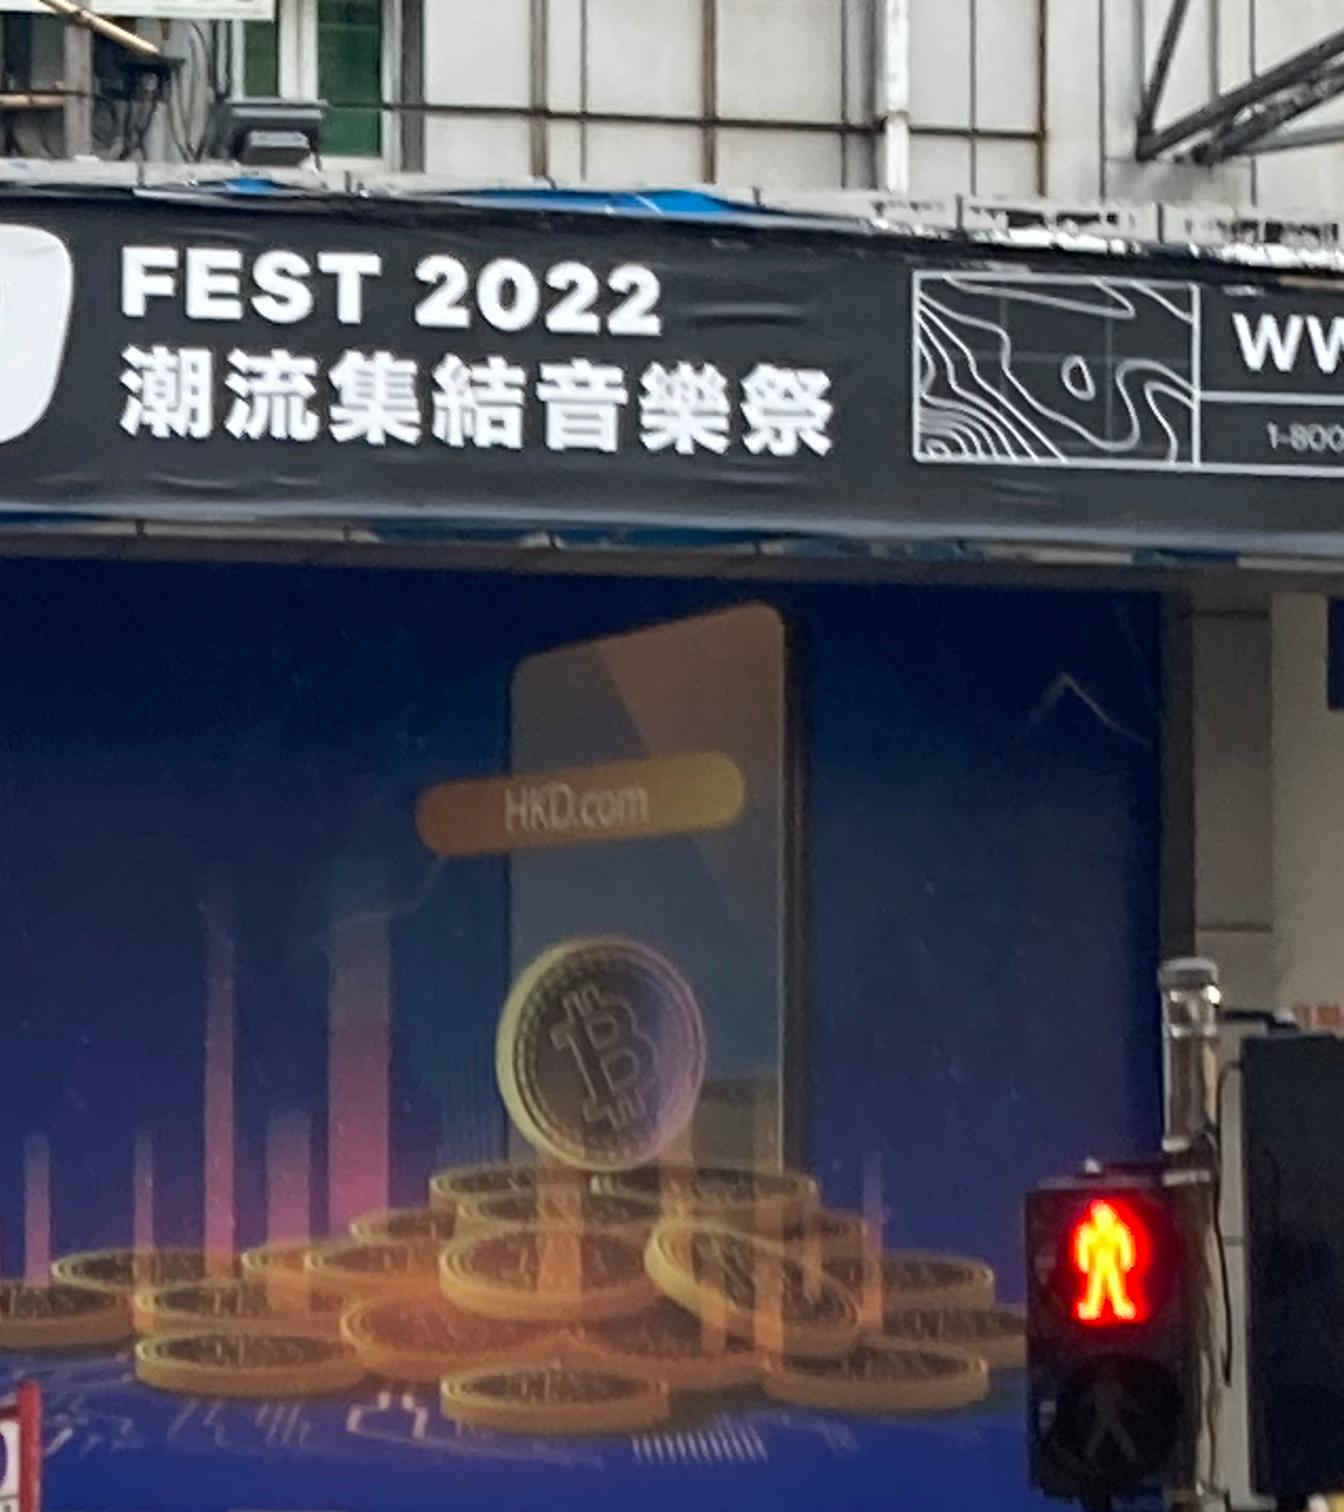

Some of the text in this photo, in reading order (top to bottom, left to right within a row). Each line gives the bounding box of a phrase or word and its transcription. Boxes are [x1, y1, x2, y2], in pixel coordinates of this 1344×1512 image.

[118, 246, 663, 338] FEST 2022
[118, 344, 834, 458] 潮流集結音樂祭
[504, 782, 650, 833] HKD.com
